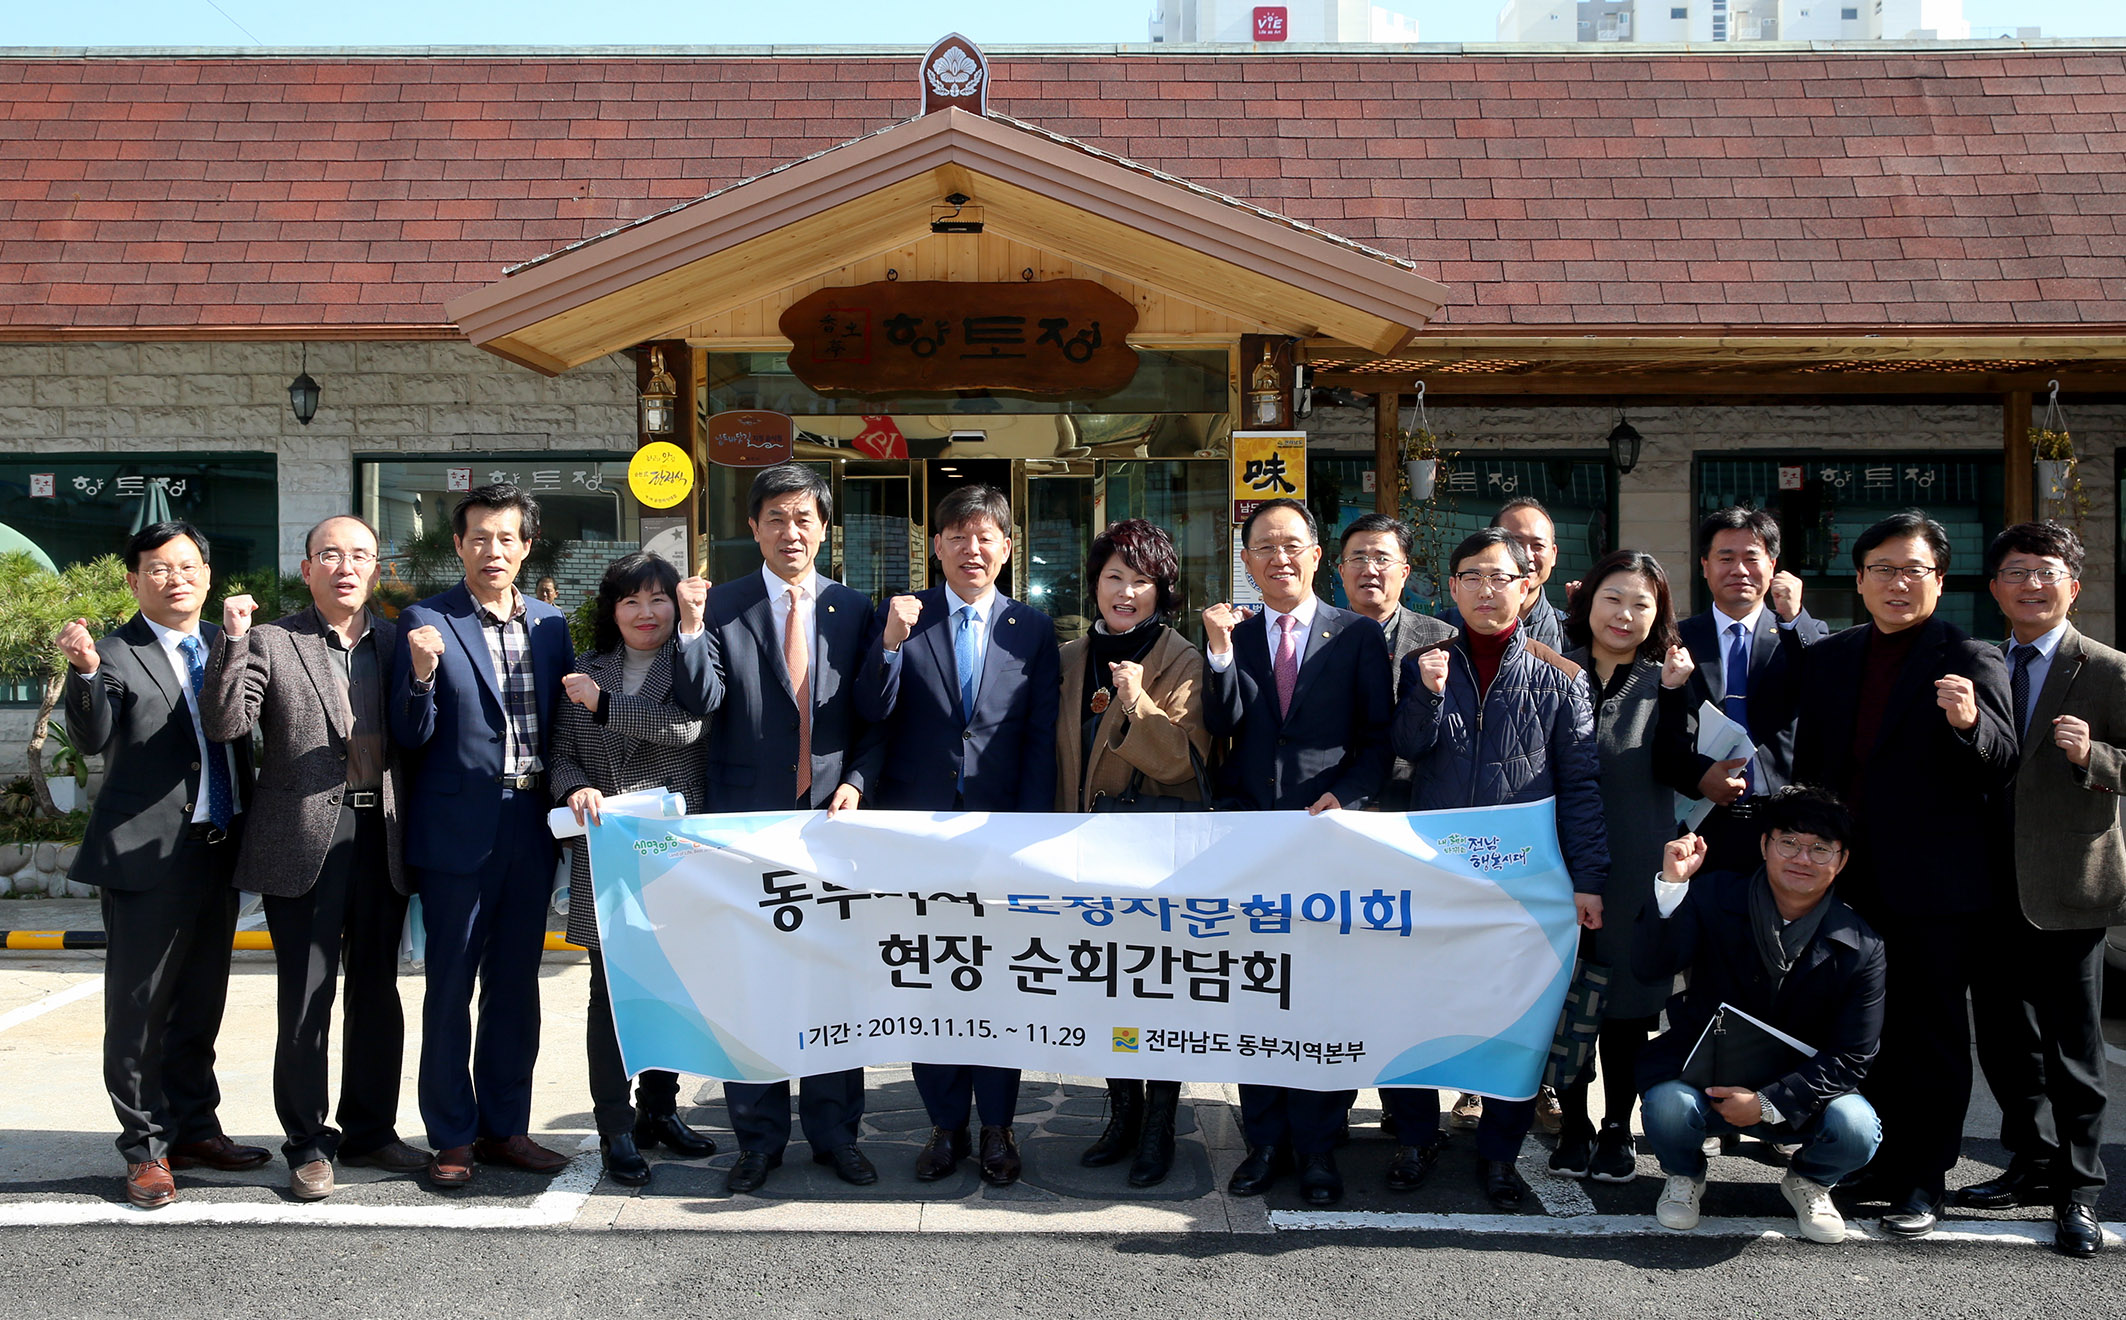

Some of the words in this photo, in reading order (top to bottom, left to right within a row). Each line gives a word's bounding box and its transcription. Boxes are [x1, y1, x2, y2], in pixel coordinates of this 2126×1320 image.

[883, 312, 1101, 363] 향토정
[72, 475, 187, 497] 향토정
[1243, 452, 1297, 494] 味
[1820, 467, 1935, 488] 향토정
[1468, 836, 1500, 852] 전남
[1470, 849, 1527, 871] 행복시대
[879, 934, 992, 992] 현장
[1009, 937, 1292, 1011] 순회간담회
[808, 1023, 851, 1047] 기간
[868, 1017, 998, 1039] 2019.11.15.
[1026, 1023, 1086, 1047] 11.29
[1145, 1029, 1231, 1054] 전라남도
[1236, 1034, 1367, 1064] 동부지역본부
